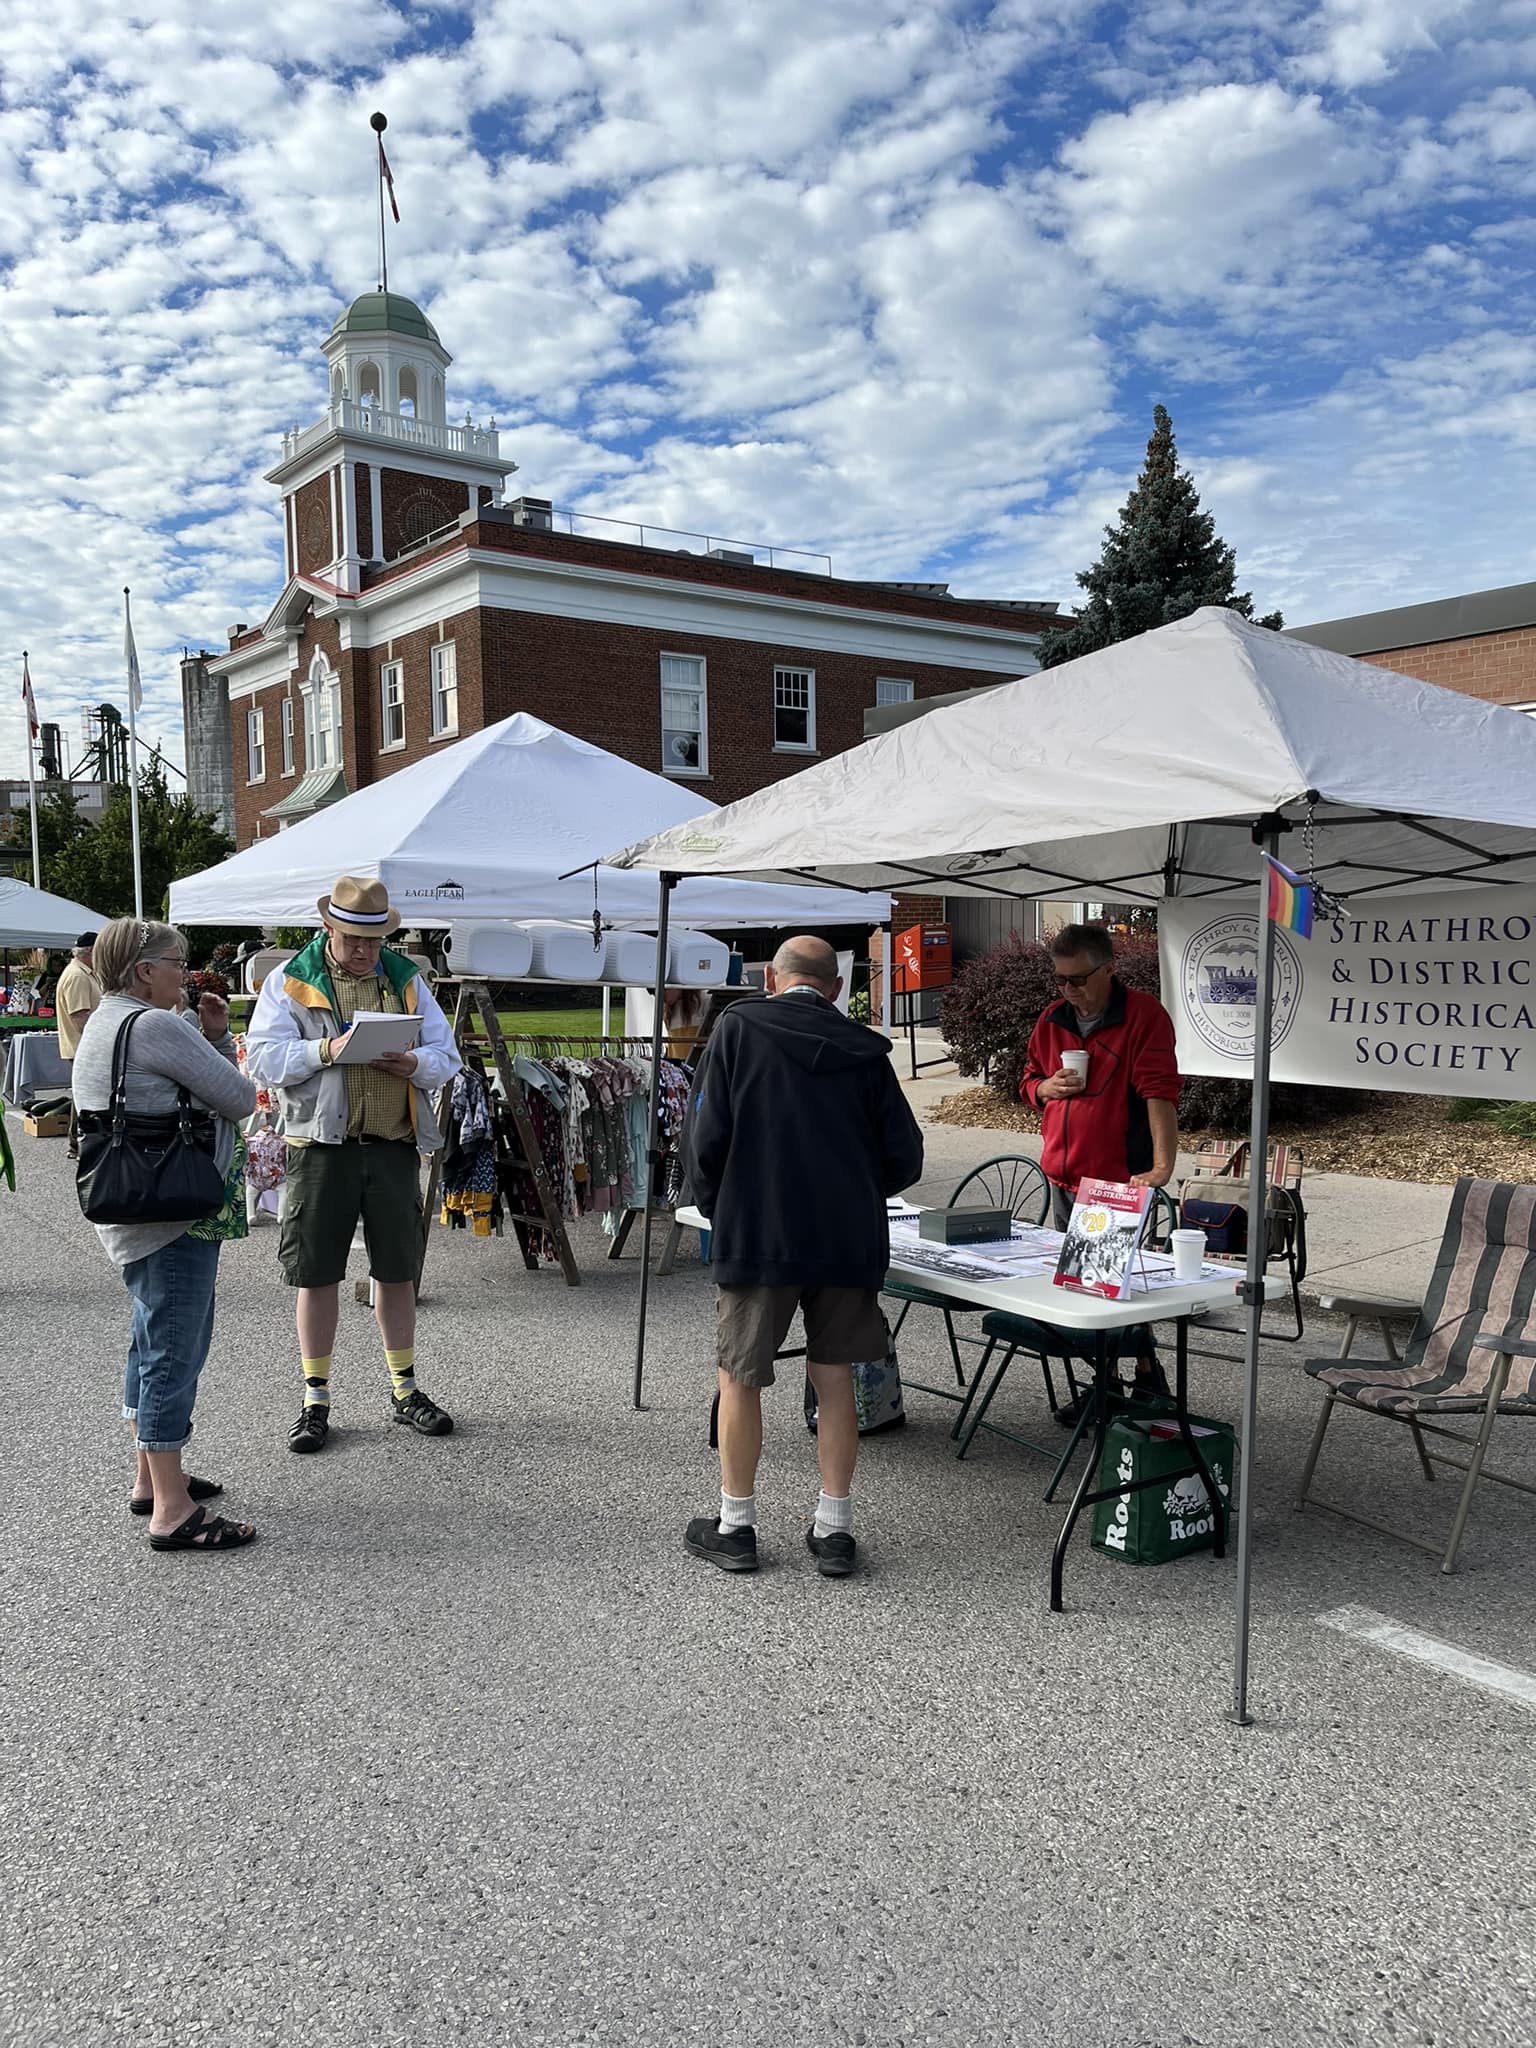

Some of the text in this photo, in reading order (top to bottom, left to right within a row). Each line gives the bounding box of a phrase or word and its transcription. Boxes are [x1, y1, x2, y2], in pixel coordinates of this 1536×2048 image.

[405, 889, 462, 897] EAGLE PEAK
[1330, 916, 1536, 943] STRATHRO
[1188, 923, 1240, 981] STRATHROY
[1243, 924, 1251, 933] &
[1331, 958, 1355, 984] &
[1194, 1011, 1249, 1051] HISTORICAL
[1356, 1036, 1522, 1072] SOCIETY
[1081, 1211, 1106, 1232] $20
[1169, 1513, 1216, 1541] Root
